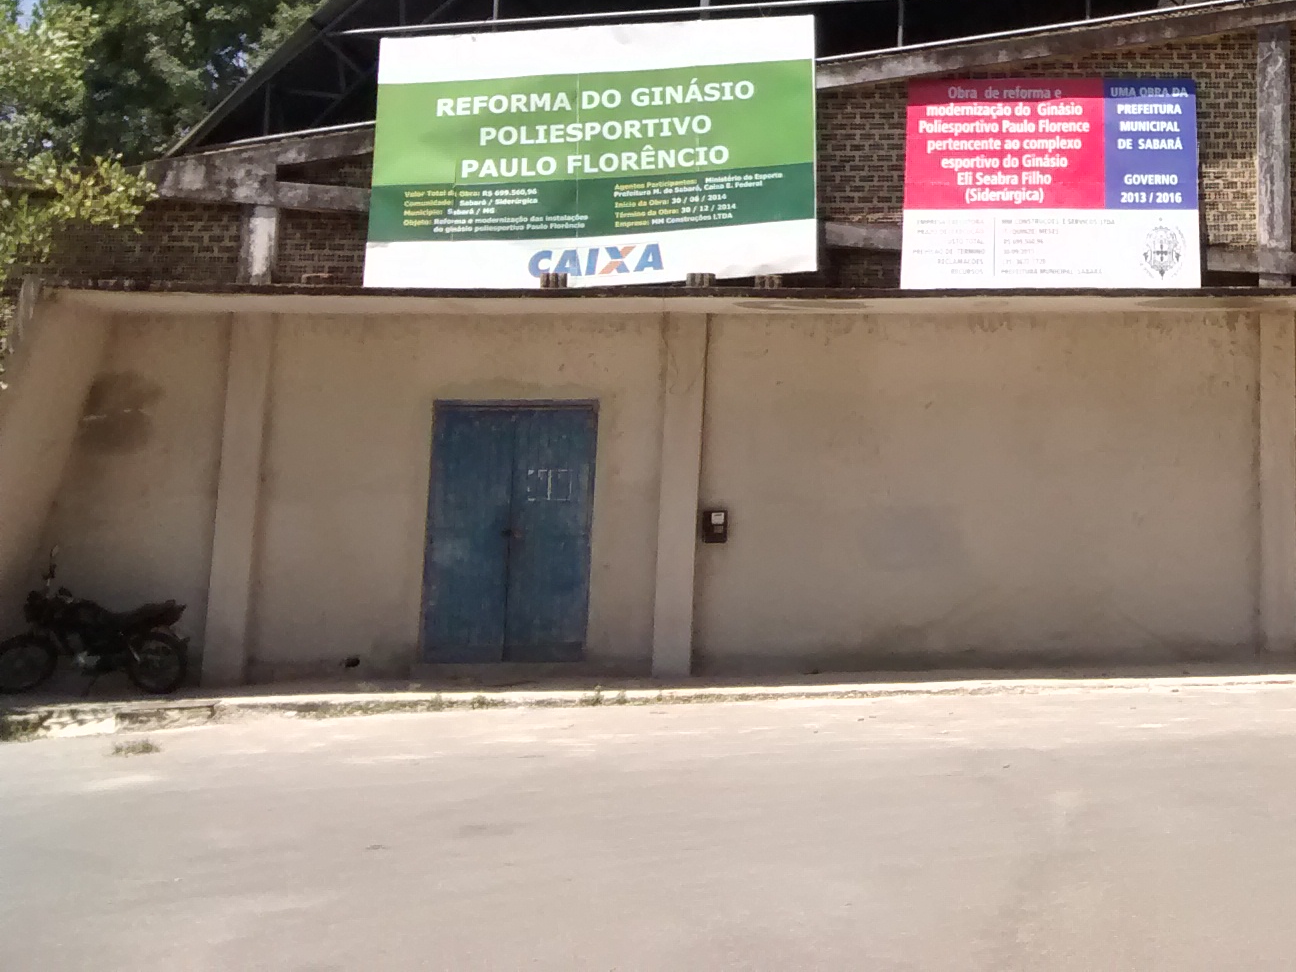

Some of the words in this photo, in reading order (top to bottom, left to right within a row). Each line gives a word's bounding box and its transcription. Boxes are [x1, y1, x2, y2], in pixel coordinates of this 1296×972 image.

[436, 90, 571, 117] REFORMA
[581, 89, 621, 110] DO
[631, 78, 755, 102] GINÁSIO
[948, 86, 976, 100] Obra
[984, 87, 999, 99] de
[1004, 87, 1050, 99] reforma
[1054, 89, 1062, 99] e
[1110, 87, 1137, 98] UMA
[1140, 87, 1168, 98] OBRA
[1172, 87, 1188, 98] DA
[926, 102, 1011, 119] modernização
[1014, 102, 1030, 116] do
[1038, 102, 1082, 116] Ginásio
[1117, 104, 1182, 115] PREFEITURA
[479, 114, 711, 146] POLIESPORTIVO
[919, 120, 999, 135] Poliesportivo
[1002, 119, 1036, 133] Paulo
[1038, 119, 1090, 132] Florence
[1120, 121, 1180, 132] MUNICIPAL
[927, 138, 1001, 154] pertencente
[1004, 139, 1022, 150] ao
[1024, 137, 1082, 153] complexo
[1118, 139, 1132, 150] DE
[1138, 136, 1182, 150] SABARÁ
[461, 154, 557, 178] PAULO
[567, 144, 729, 173] FLORÊNCIO
[941, 154, 999, 170] esportivo
[1003, 154, 1018, 168] do
[1022, 154, 1068, 168] Ginásio
[958, 172, 972, 185] Eli
[976, 172, 1018, 185] Seabra
[1021, 171, 1051, 184] Filho
[1124, 174, 1178, 186] GOVERNO
[966, 188, 1043, 205] (Siderúrgica)
[1120, 192, 1146, 203] 2013
[1149, 192, 1154, 204] /
[1156, 192, 1182, 203] 2016
[717, 203, 736, 211] 2014
[528, 243, 663, 278] CAIXA
